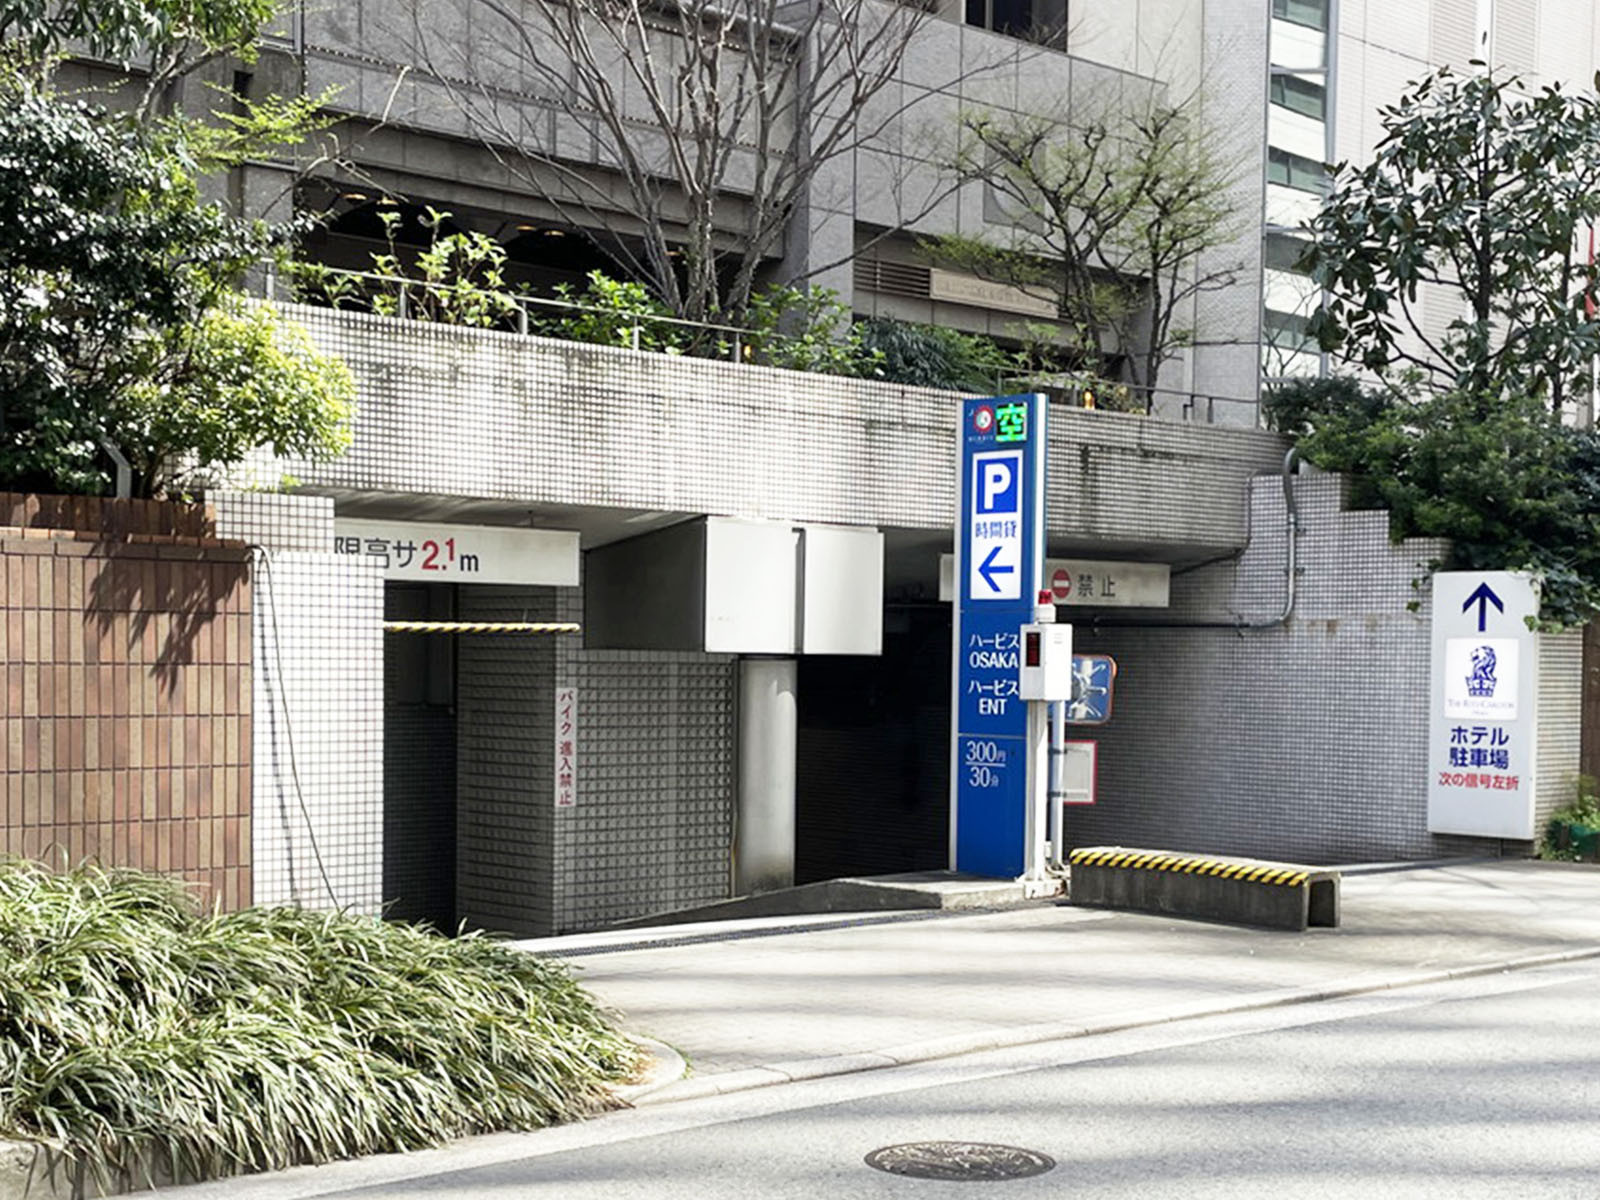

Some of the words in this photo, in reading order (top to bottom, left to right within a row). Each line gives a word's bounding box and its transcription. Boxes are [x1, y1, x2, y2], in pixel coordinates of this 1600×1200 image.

[995, 403, 1027, 442] 空
[984, 462, 1011, 510] P
[975, 520, 1017, 539] 時間貸
[1077, 573, 1116, 597] 禁止
[968, 633, 1020, 650] ハービス
[969, 651, 1019, 668] OSAKA
[968, 679, 1019, 697] ハービス
[979, 697, 1008, 715] ENT
[1450, 725, 1510, 746] ホテル
[1448, 747, 1510, 770] 駐車場
[1438, 772, 1520, 791] 次の信号左折
